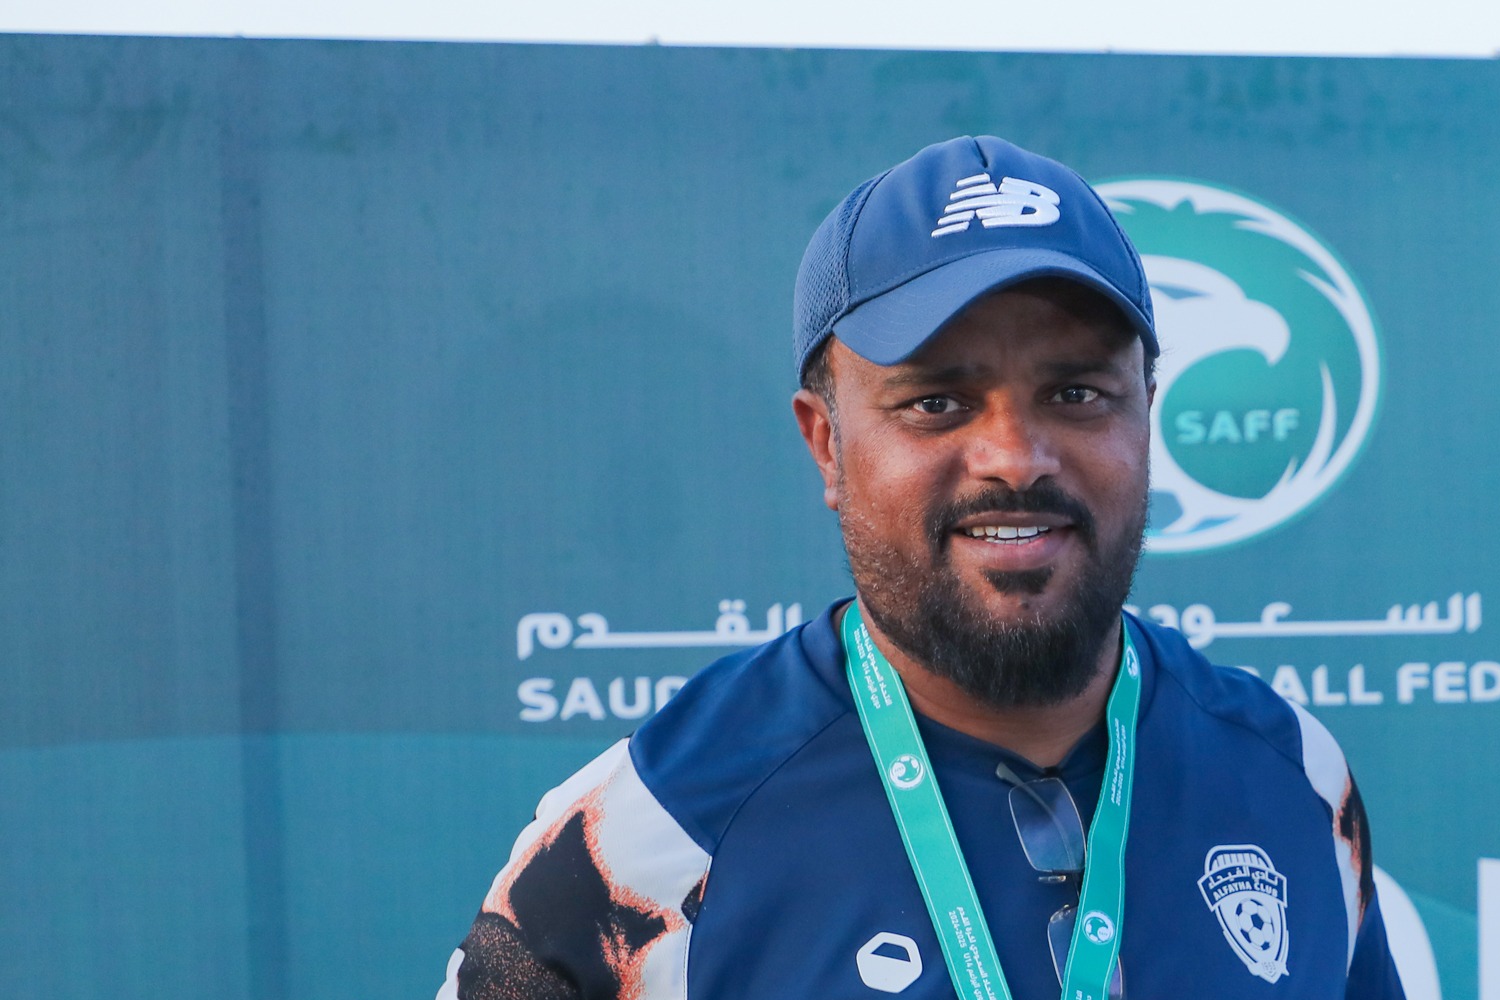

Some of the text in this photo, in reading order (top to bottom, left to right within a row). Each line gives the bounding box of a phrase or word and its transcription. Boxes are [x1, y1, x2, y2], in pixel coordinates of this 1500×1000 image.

[1175, 409, 1300, 445] SAFF
[1235, 664, 1384, 706] ALL
[1213, 881, 1278, 901] ALFAYHA CLUB
[948, 910, 967, 948] 2024-2025
[963, 952, 973, 968] U14
